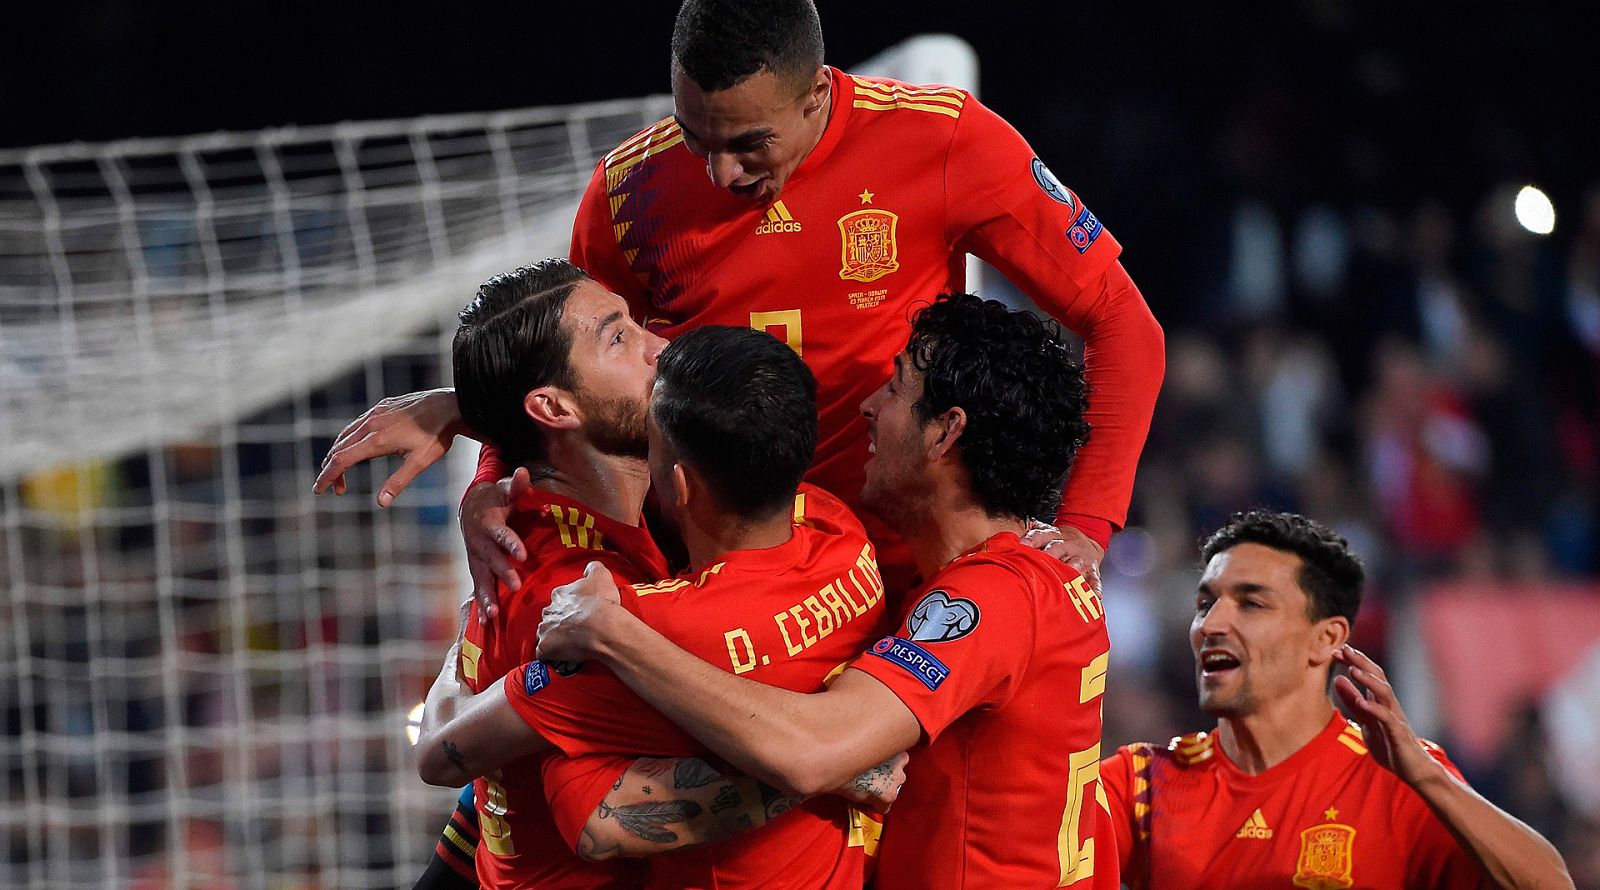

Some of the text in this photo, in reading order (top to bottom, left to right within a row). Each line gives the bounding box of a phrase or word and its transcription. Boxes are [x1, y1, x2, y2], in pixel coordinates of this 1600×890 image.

[756, 220, 802, 235] adidas
[723, 627, 770, 675] D.
[890, 644, 946, 683] RESPECT
